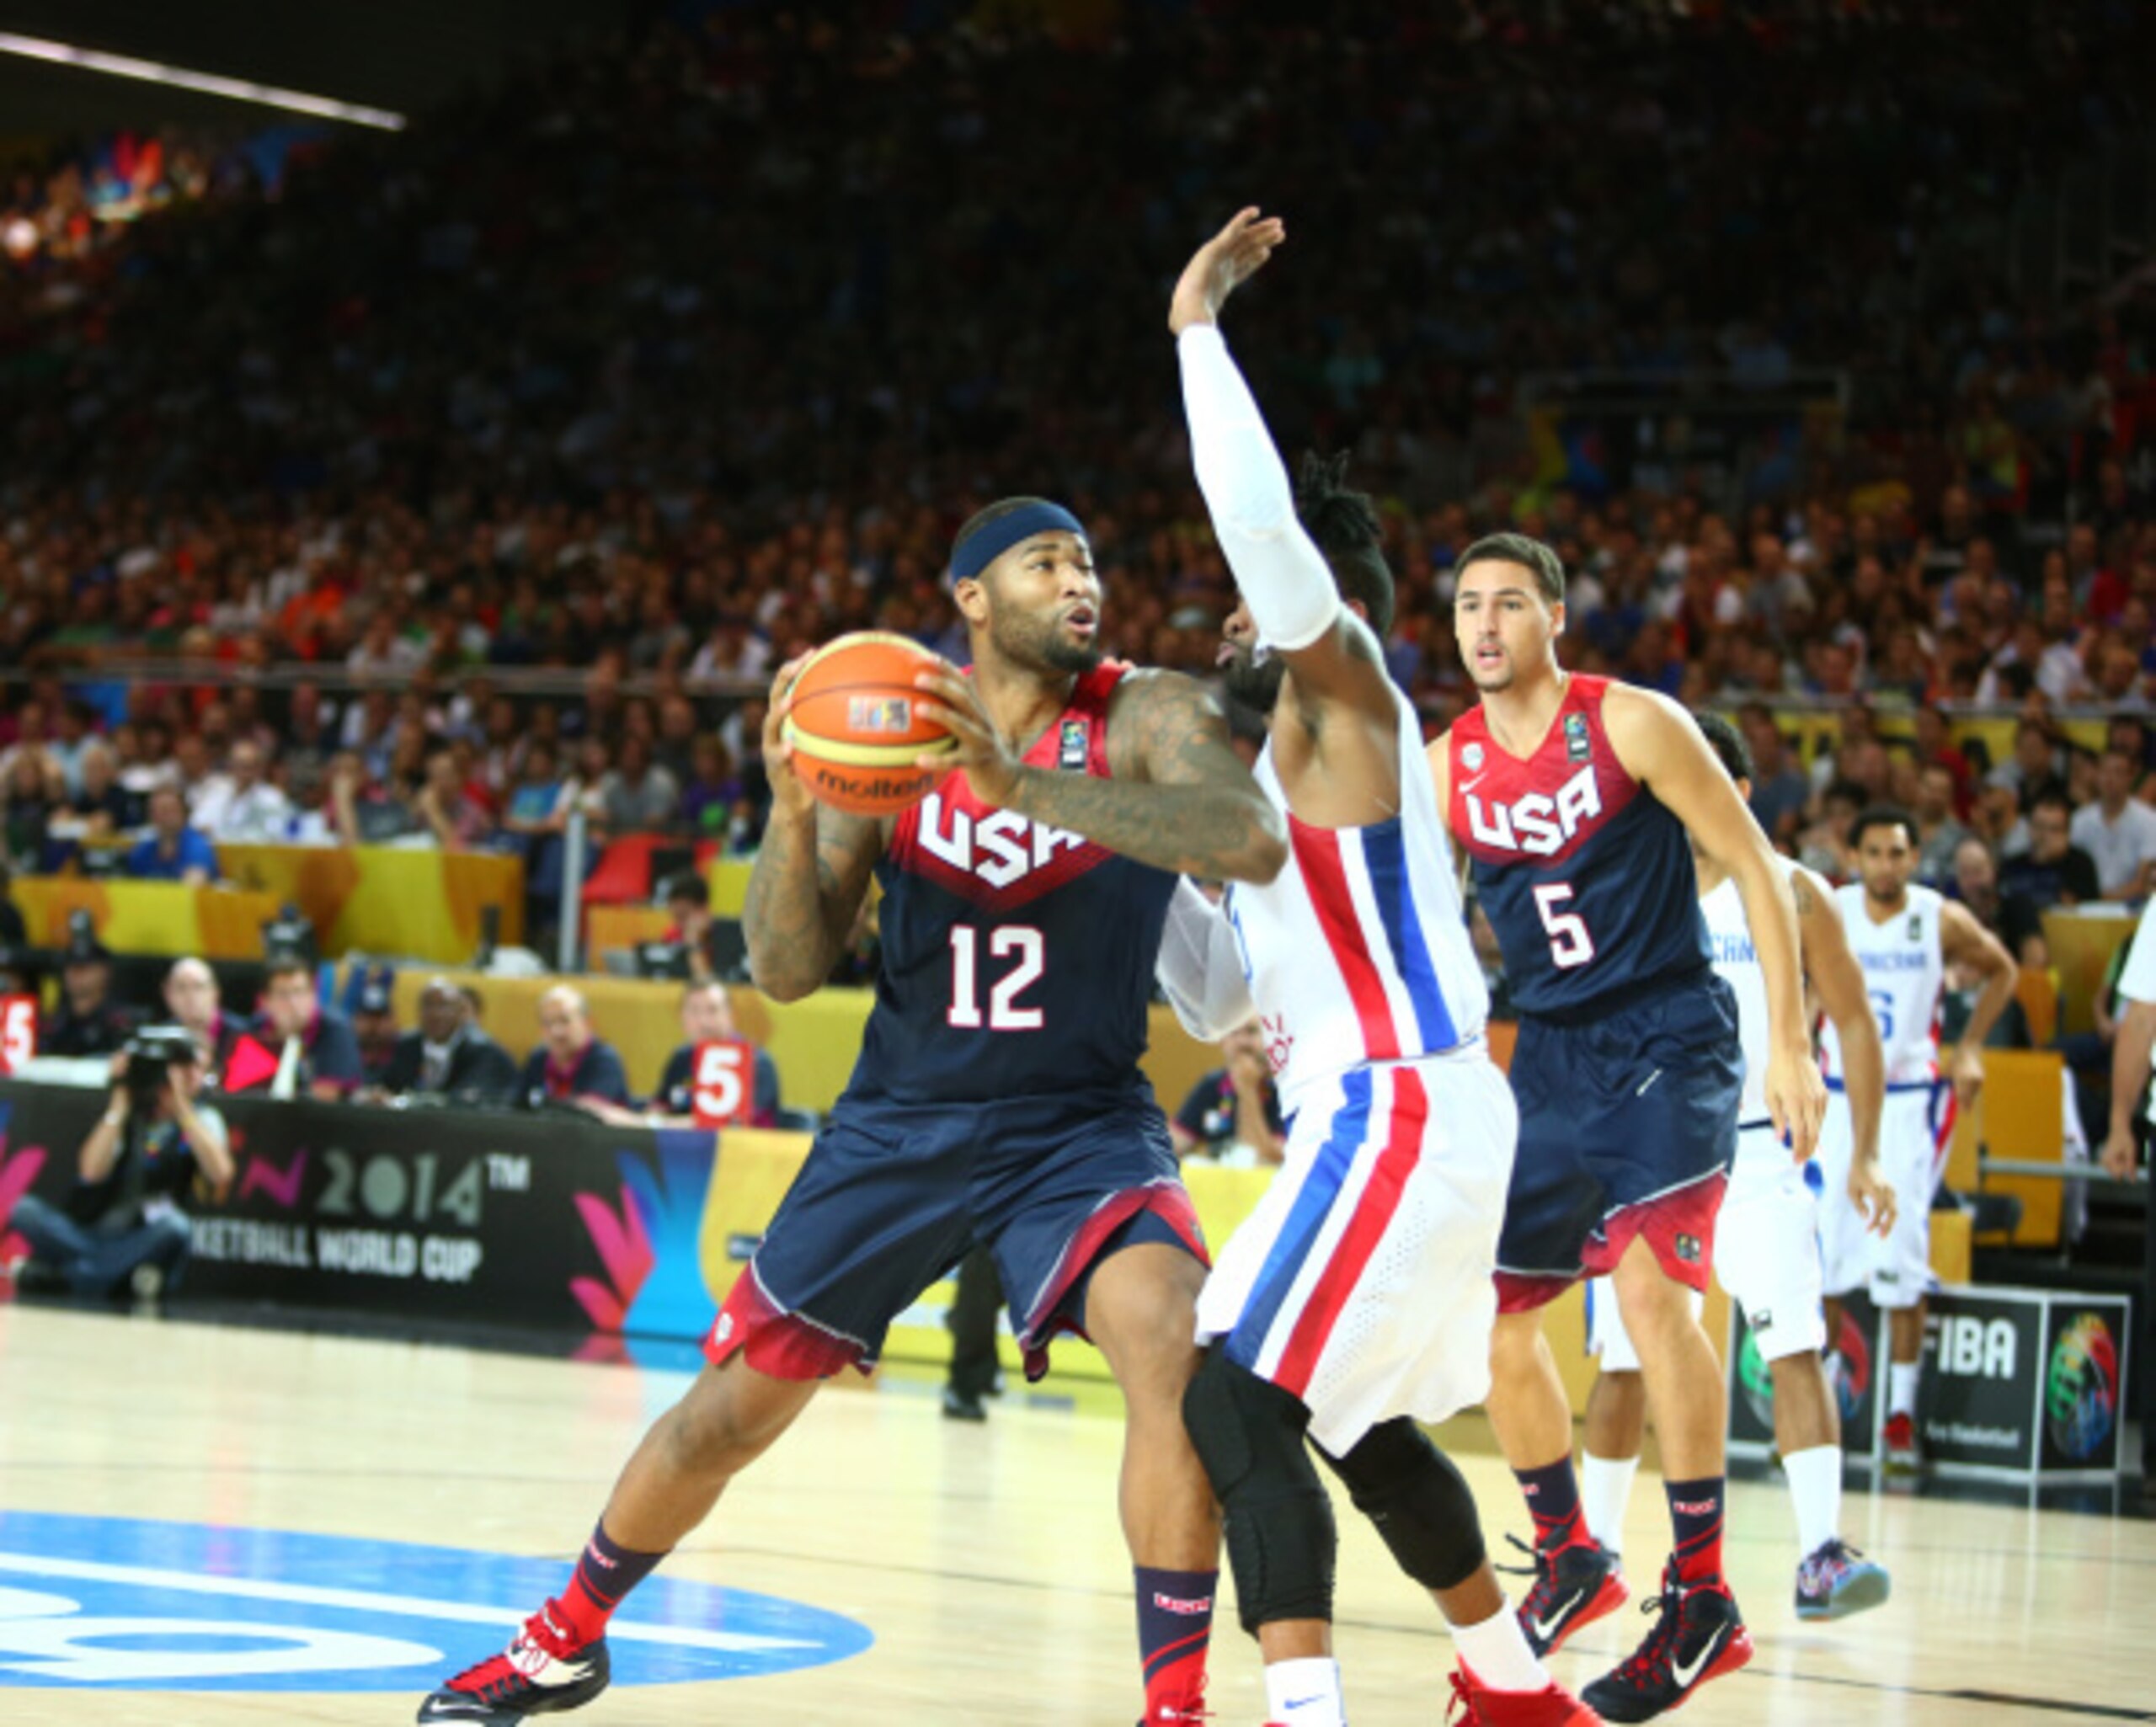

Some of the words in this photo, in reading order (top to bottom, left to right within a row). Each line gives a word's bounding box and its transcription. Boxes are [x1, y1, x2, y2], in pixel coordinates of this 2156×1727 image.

[817, 767, 934, 801] molten
[1466, 764, 1601, 856] USA
[1532, 882, 1595, 969] 5
[946, 923, 1045, 1031] 12
[696, 1045, 742, 1117] 5
[317, 1146, 483, 1227] 2014
[486, 1153, 531, 1191] TM
[316, 1227, 419, 1277] WORLD
[422, 1235, 483, 1283] CUP
